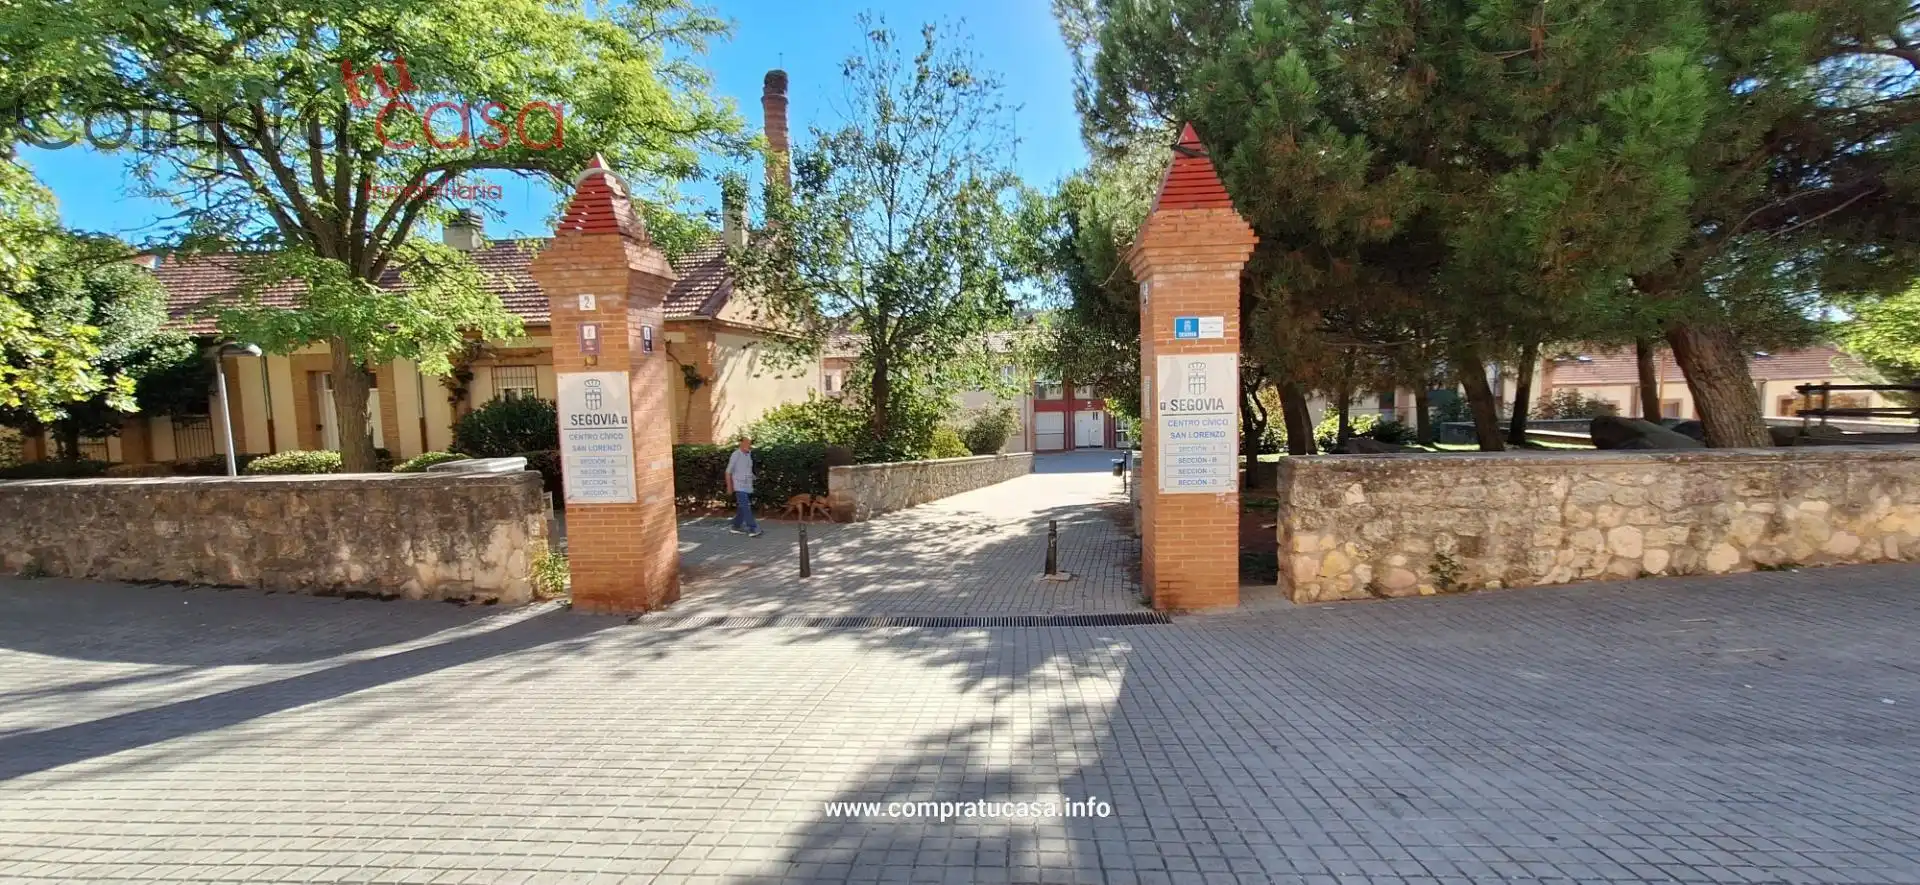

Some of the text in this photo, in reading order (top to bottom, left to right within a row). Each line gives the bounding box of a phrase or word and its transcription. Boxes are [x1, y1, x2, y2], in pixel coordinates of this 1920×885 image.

[584, 295, 590, 308] 2
[1170, 398, 1225, 411] SEGOVIA
[571, 413, 619, 426] SEGOVIA
[1167, 418, 1229, 427] CENTRO CÍVICO
[569, 431, 624, 441] CENTRO CÍVICO
[1188, 430, 1226, 439] LORENZO
[572, 443, 622, 452] SAN LORENZO
